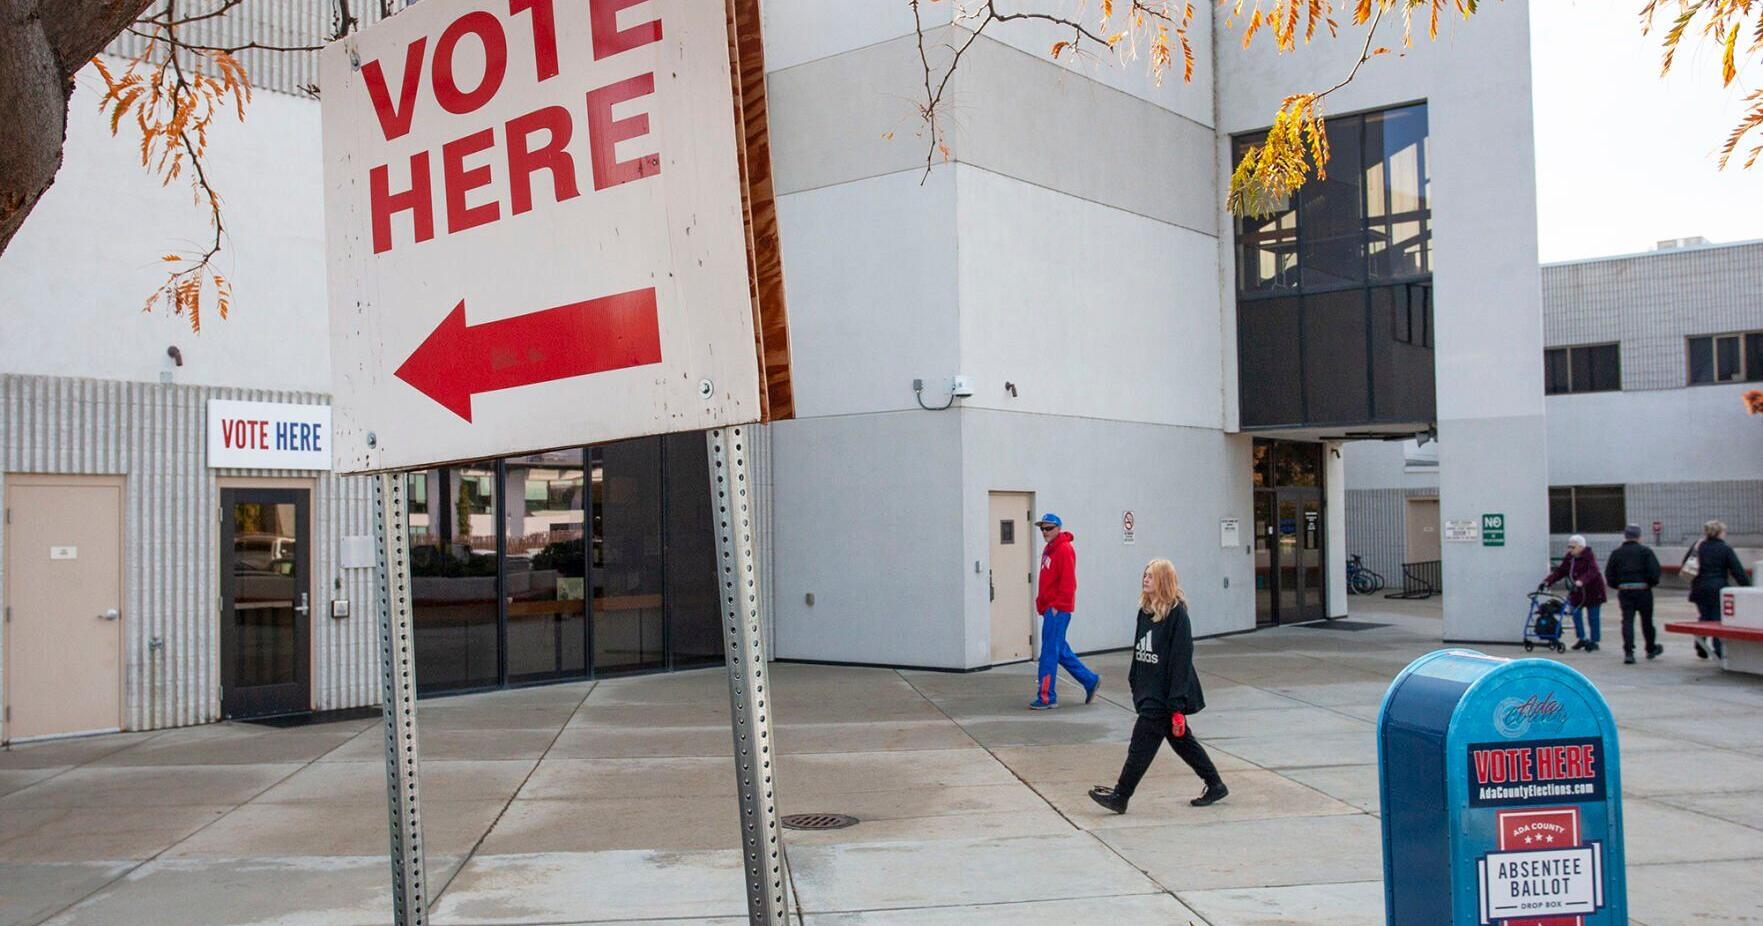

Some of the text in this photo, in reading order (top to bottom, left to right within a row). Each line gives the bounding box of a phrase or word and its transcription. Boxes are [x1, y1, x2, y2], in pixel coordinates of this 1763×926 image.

[361, 0, 663, 142] VOTE
[369, 72, 661, 254] HERE
[221, 419, 322, 451] VOTE HERE
[1516, 691, 1563, 715] Ada
[1473, 744, 1595, 784] VOTE HERE
[1479, 783, 1594, 800] AdaCountyElections.com
[1513, 822, 1565, 837] ADA COUNTY
[1498, 858, 1582, 879] ABSENTEE
[1511, 878, 1570, 897] BALLOT
